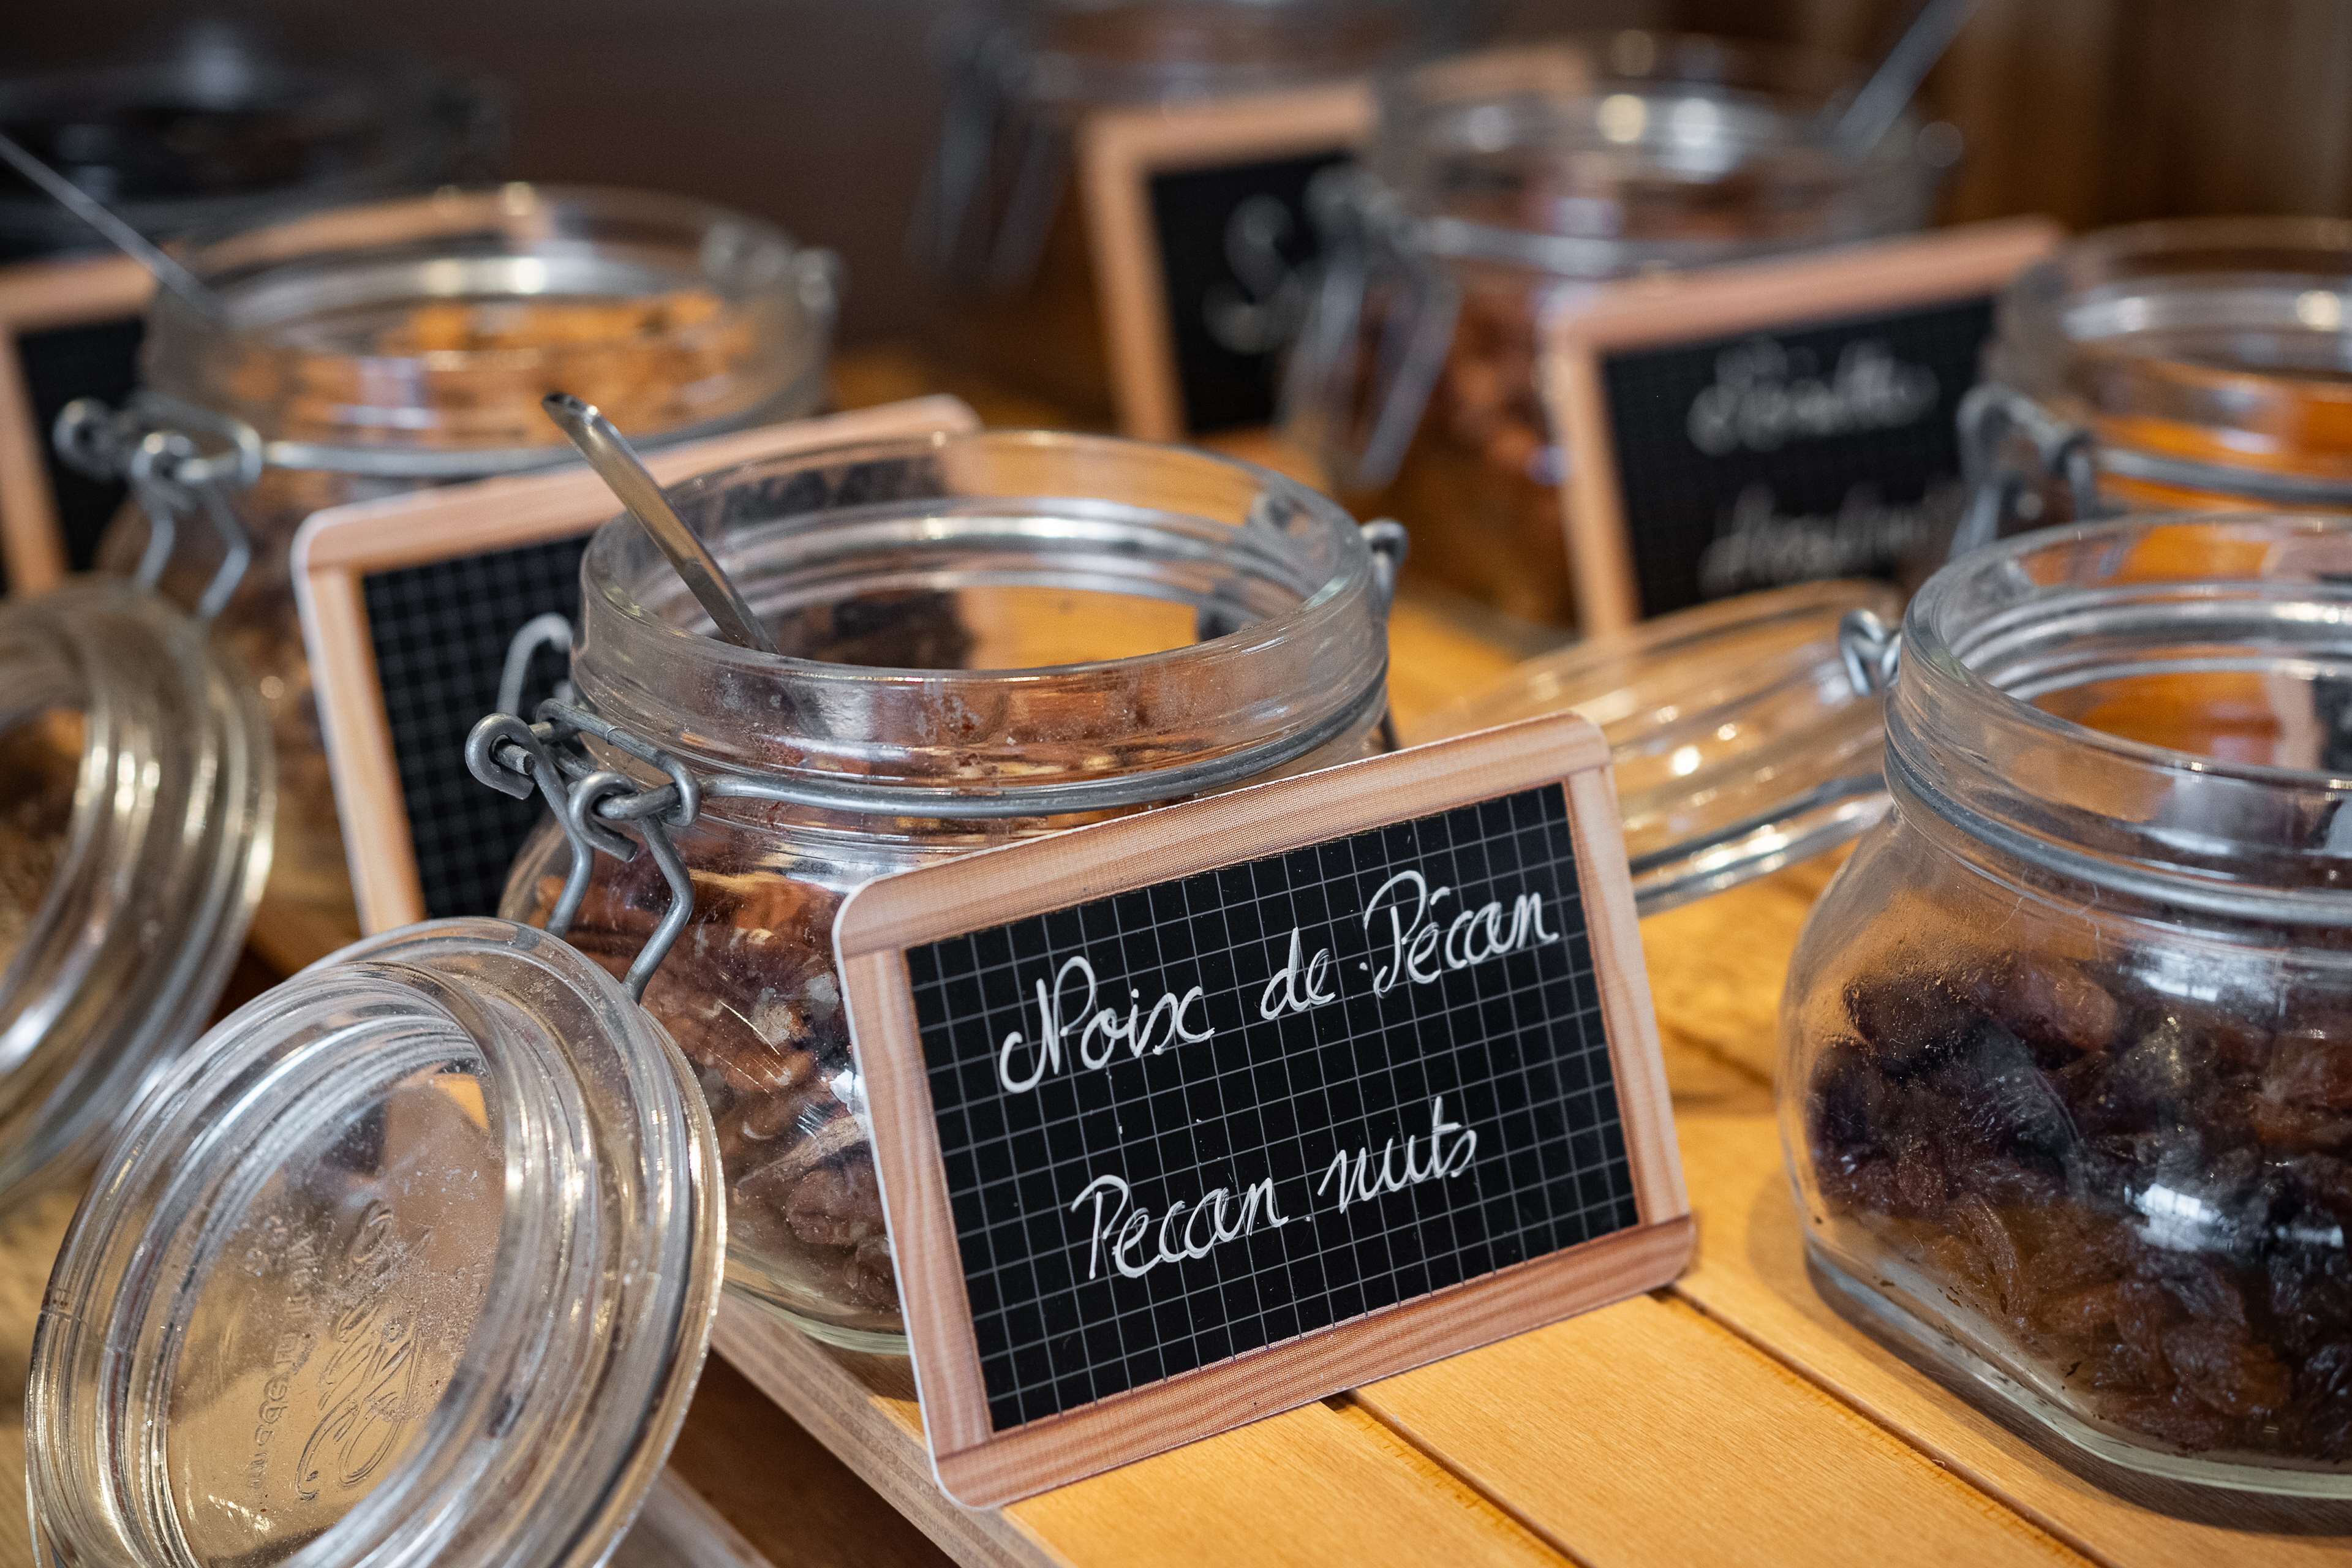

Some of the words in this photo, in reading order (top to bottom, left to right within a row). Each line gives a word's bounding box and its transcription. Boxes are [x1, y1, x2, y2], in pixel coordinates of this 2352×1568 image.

[999, 956, 1215, 1093] Noix
[1260, 927, 1336, 1020] de
[1359, 870, 1559, 999] Pécan
[1071, 1174, 1289, 1280] Pecan
[1317, 1096, 1477, 1214] nuts
